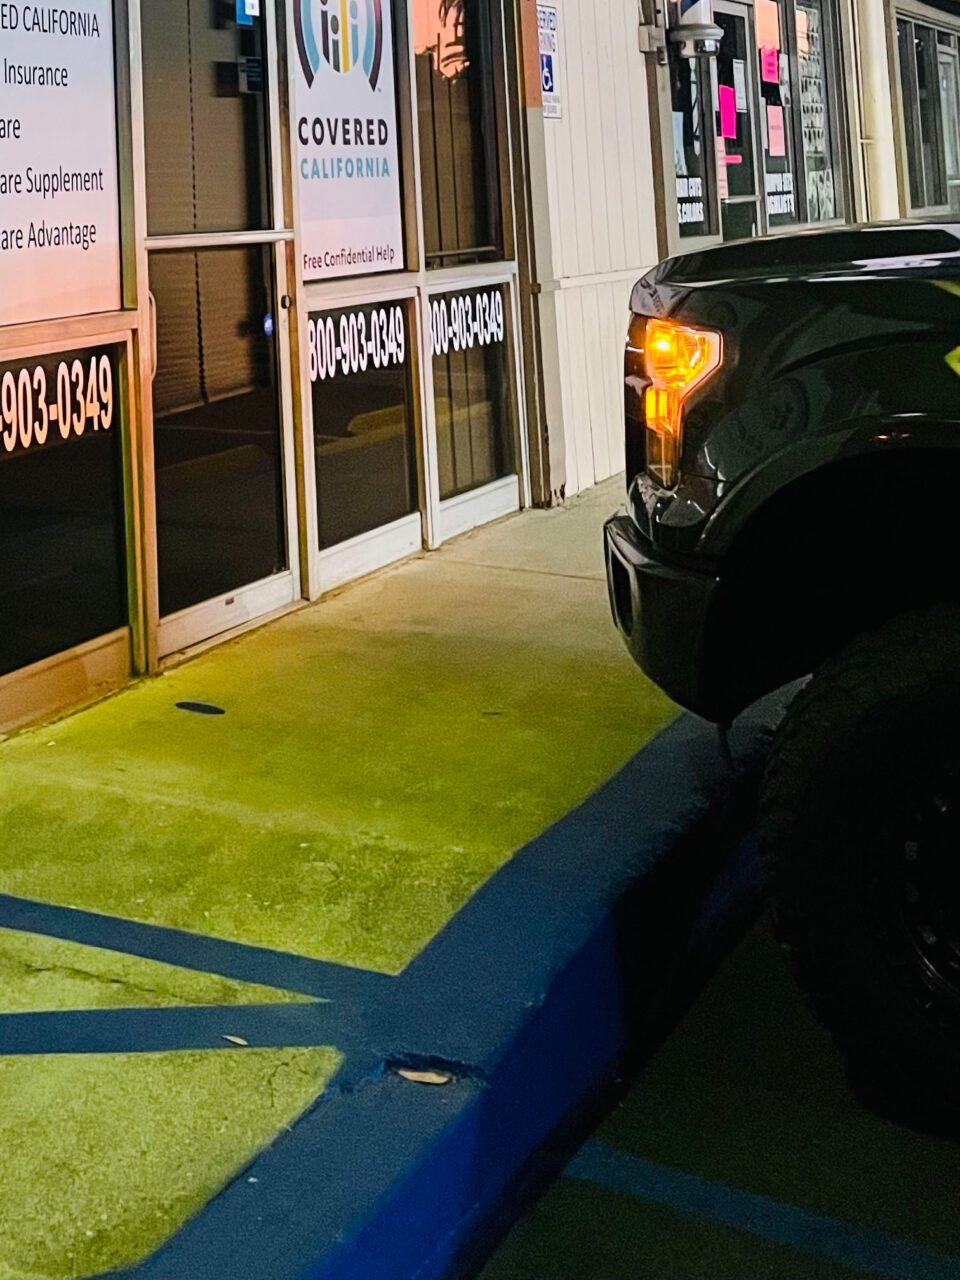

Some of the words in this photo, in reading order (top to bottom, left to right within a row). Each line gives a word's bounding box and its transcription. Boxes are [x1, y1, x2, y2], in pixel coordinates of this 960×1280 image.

[23, 6, 100, 38] CALIFORNIA
[4, 58, 68, 86] Insurance
[298, 117, 388, 146] COVERED
[26, 165, 104, 199] Supplement
[300, 157, 390, 180] CALIFORNIA
[27, 220, 97, 250] Advantage
[303, 254, 322, 269] Free
[324, 247, 375, 267] Confidential
[376, 244, 395, 263] Help
[307, 306, 405, 382] 800-903-0349
